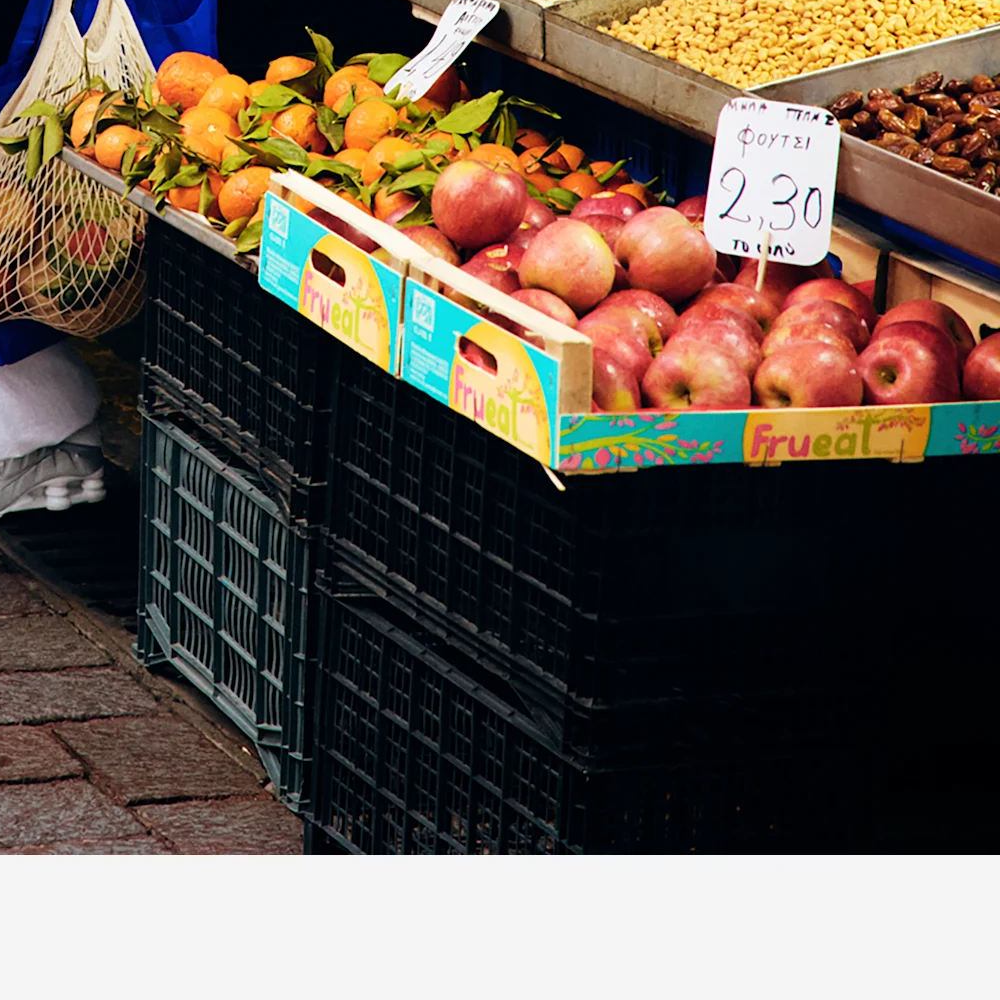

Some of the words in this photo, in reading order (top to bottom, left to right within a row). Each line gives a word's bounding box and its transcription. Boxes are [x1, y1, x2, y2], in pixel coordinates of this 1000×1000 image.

[737, 123, 811, 158] ΦΟΥΤΣΙ
[719, 167, 823, 232] 2,30
[302, 271, 363, 344] Frueat
[453, 363, 520, 441] Frueat
[750, 413, 873, 458] Frueat
